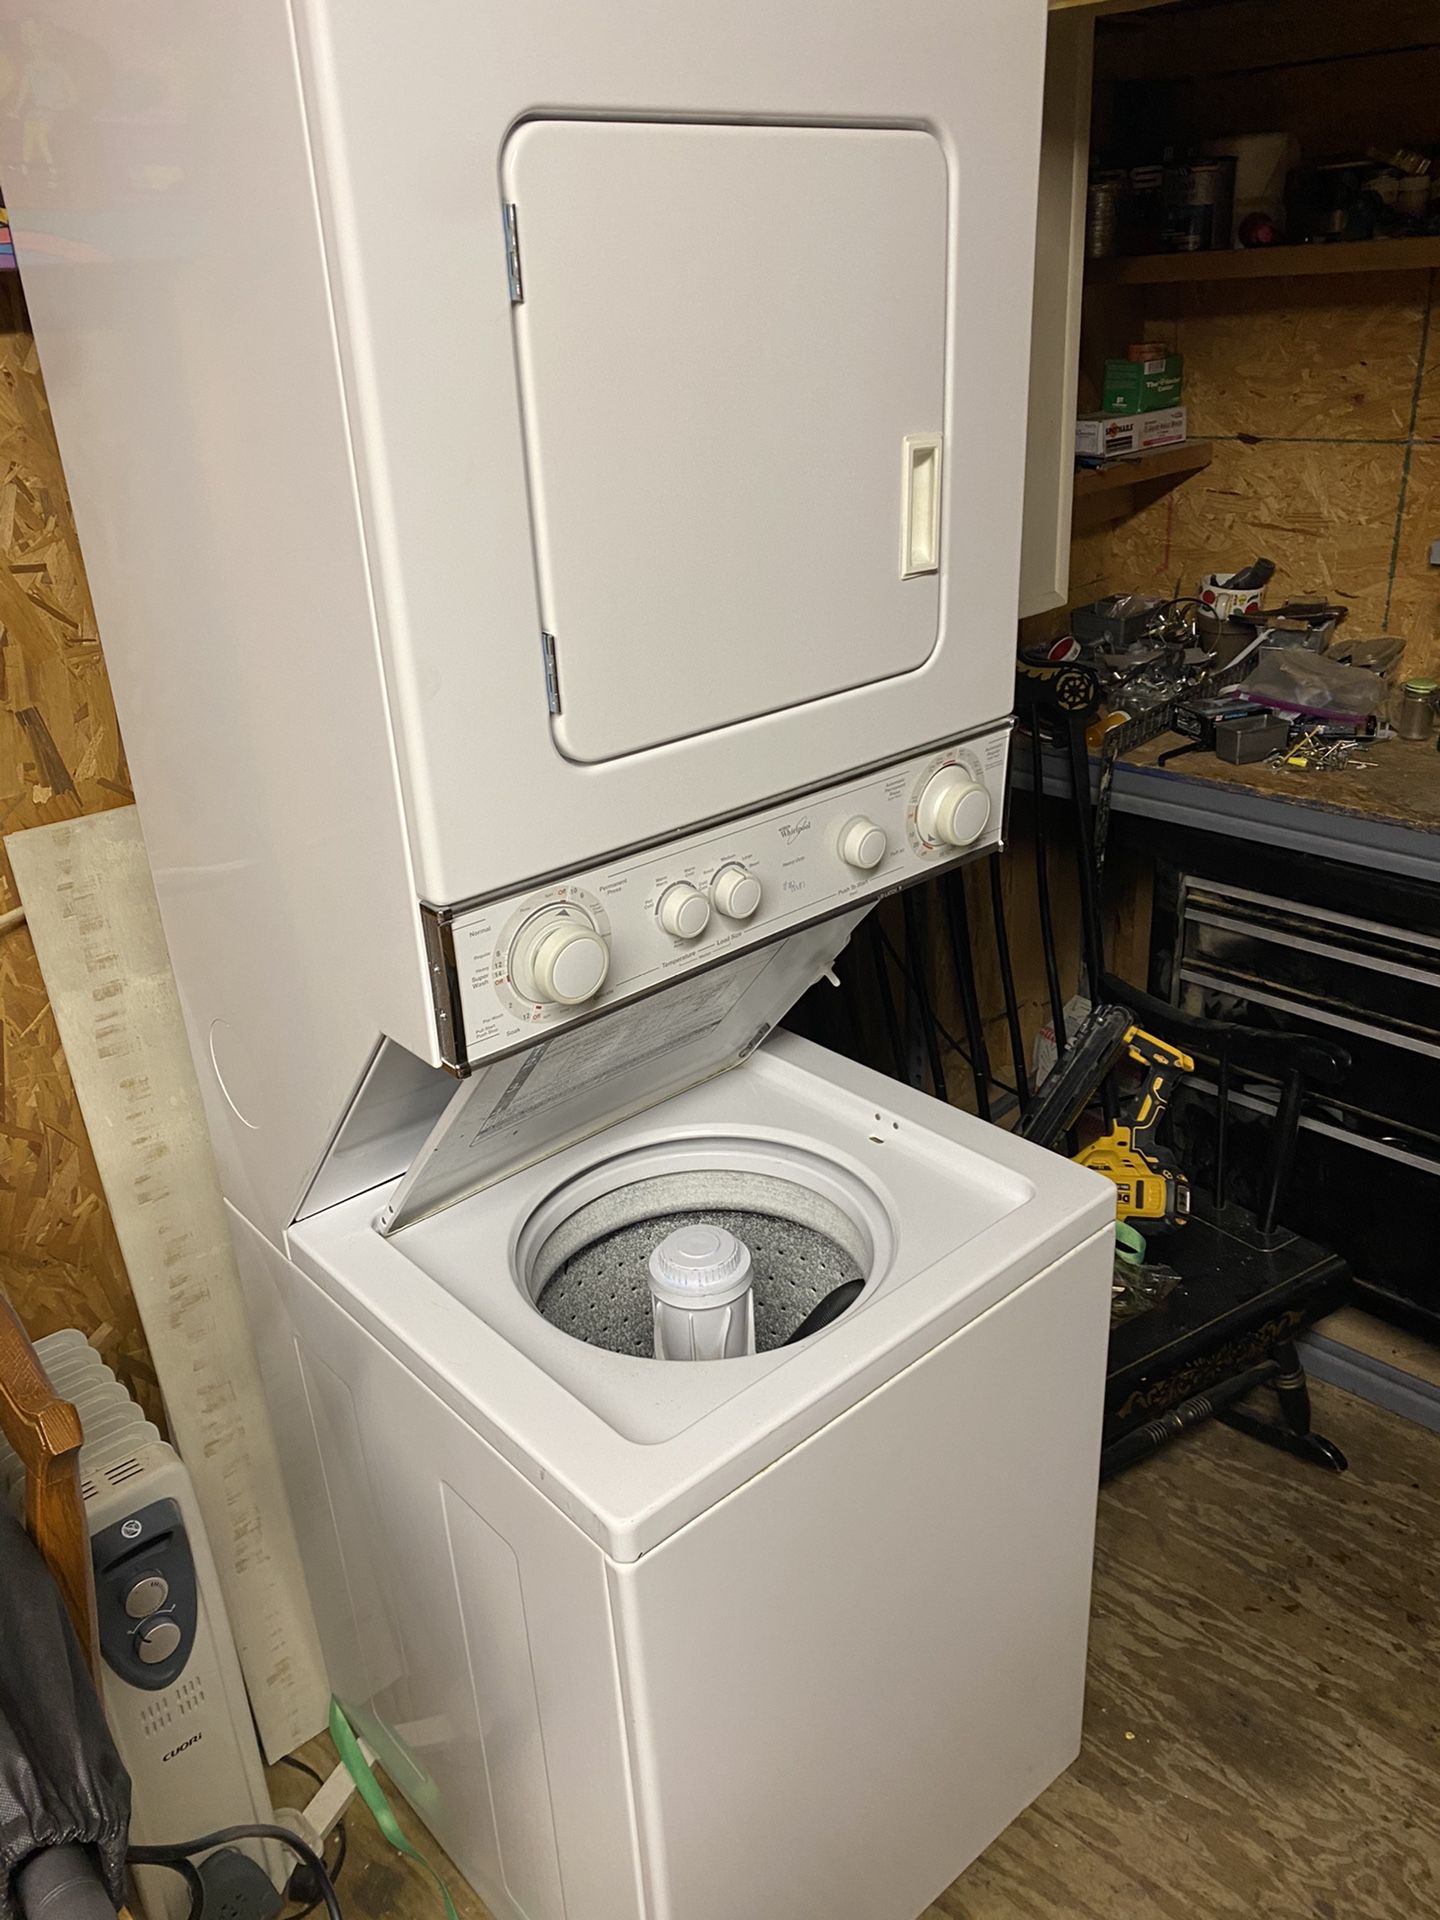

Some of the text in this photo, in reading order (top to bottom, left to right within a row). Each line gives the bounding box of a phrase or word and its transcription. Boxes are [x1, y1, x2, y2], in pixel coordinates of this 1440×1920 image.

[778, 818, 811, 841] Whirlpool
[599, 878, 628, 892] Permanent
[557, 888, 567, 896] Off
[570, 887, 578, 895] 10
[606, 887, 622, 896] Press
[469, 926, 491, 937] Normal
[716, 931, 742, 946] Load Size
[662, 951, 696, 968] Temperature
[494, 961, 502, 969] 12
[472, 973, 489, 983] Super
[494, 978, 504, 986] Off
[472, 980, 489, 989] Wash
[523, 1012, 530, 1021] 12
[506, 1027, 521, 1037] Soak
